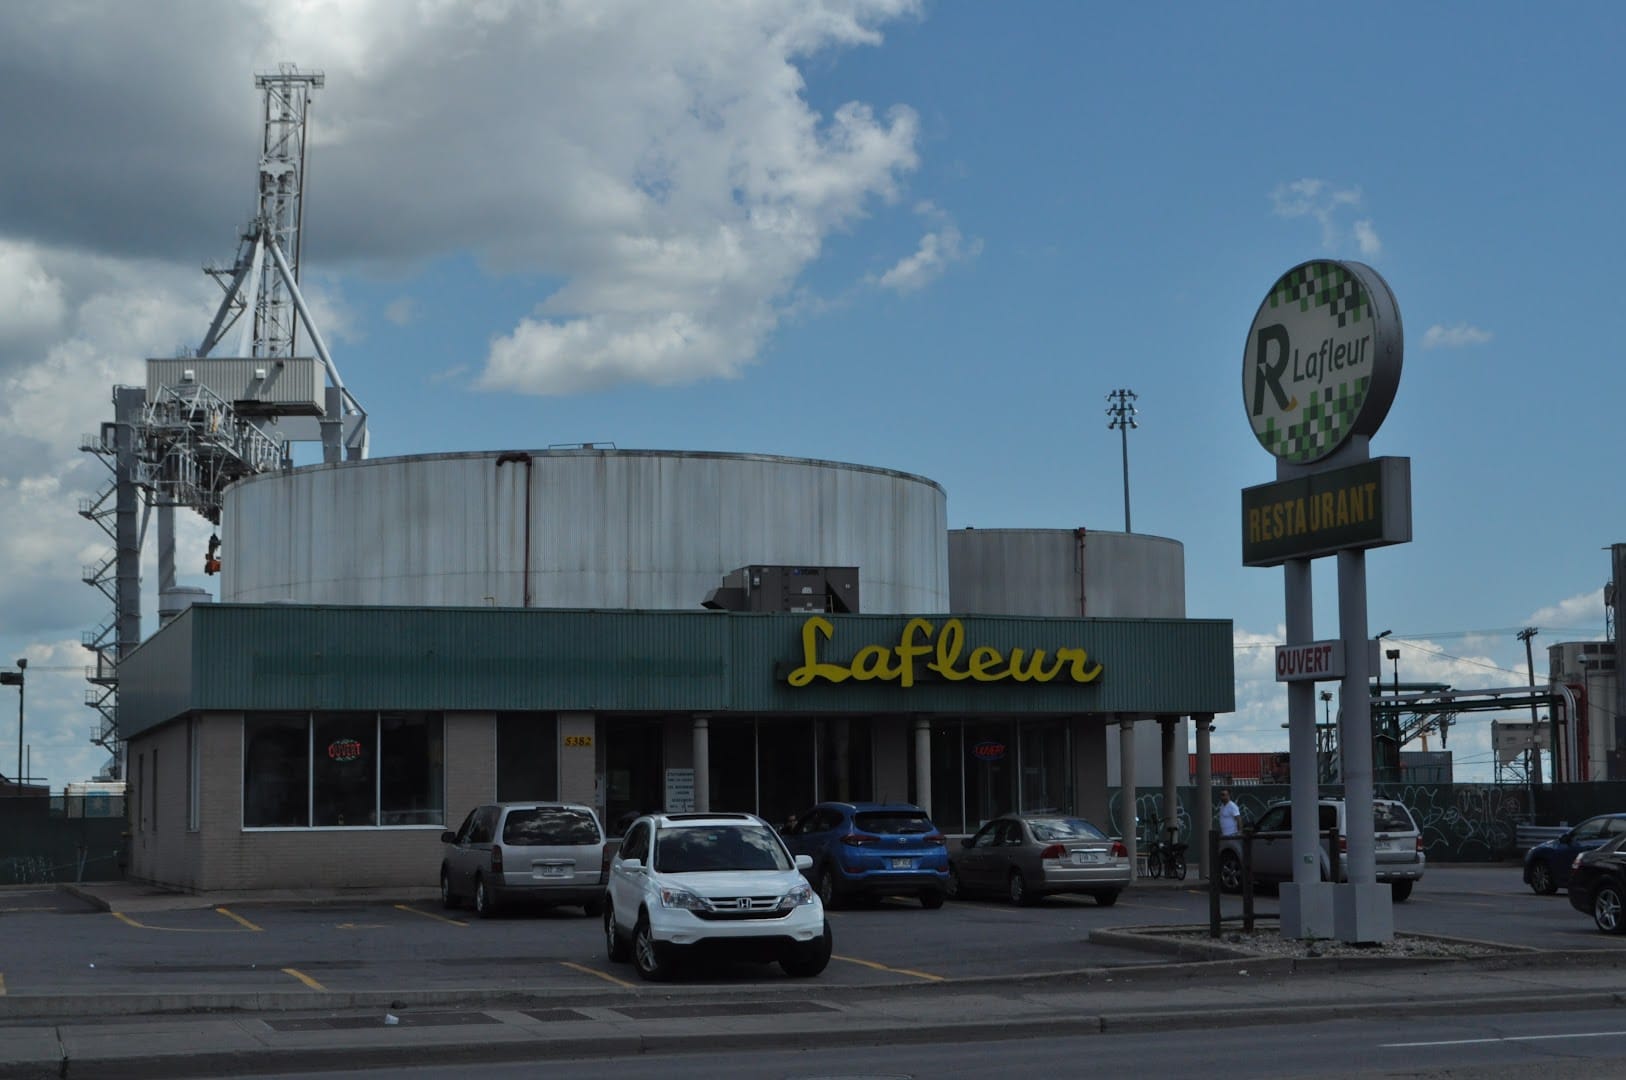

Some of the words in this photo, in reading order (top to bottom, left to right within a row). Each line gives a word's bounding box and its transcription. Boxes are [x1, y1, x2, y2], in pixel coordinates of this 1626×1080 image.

[1252, 323, 1293, 417] R
[1293, 335, 1370, 384] Lafleur
[1249, 482, 1377, 543] RESTAURANT
[787, 616, 1103, 688] Lafleur
[1277, 645, 1332, 676] OUVERT
[328, 742, 361, 758] OUVERT
[565, 736, 592, 747] 5382
